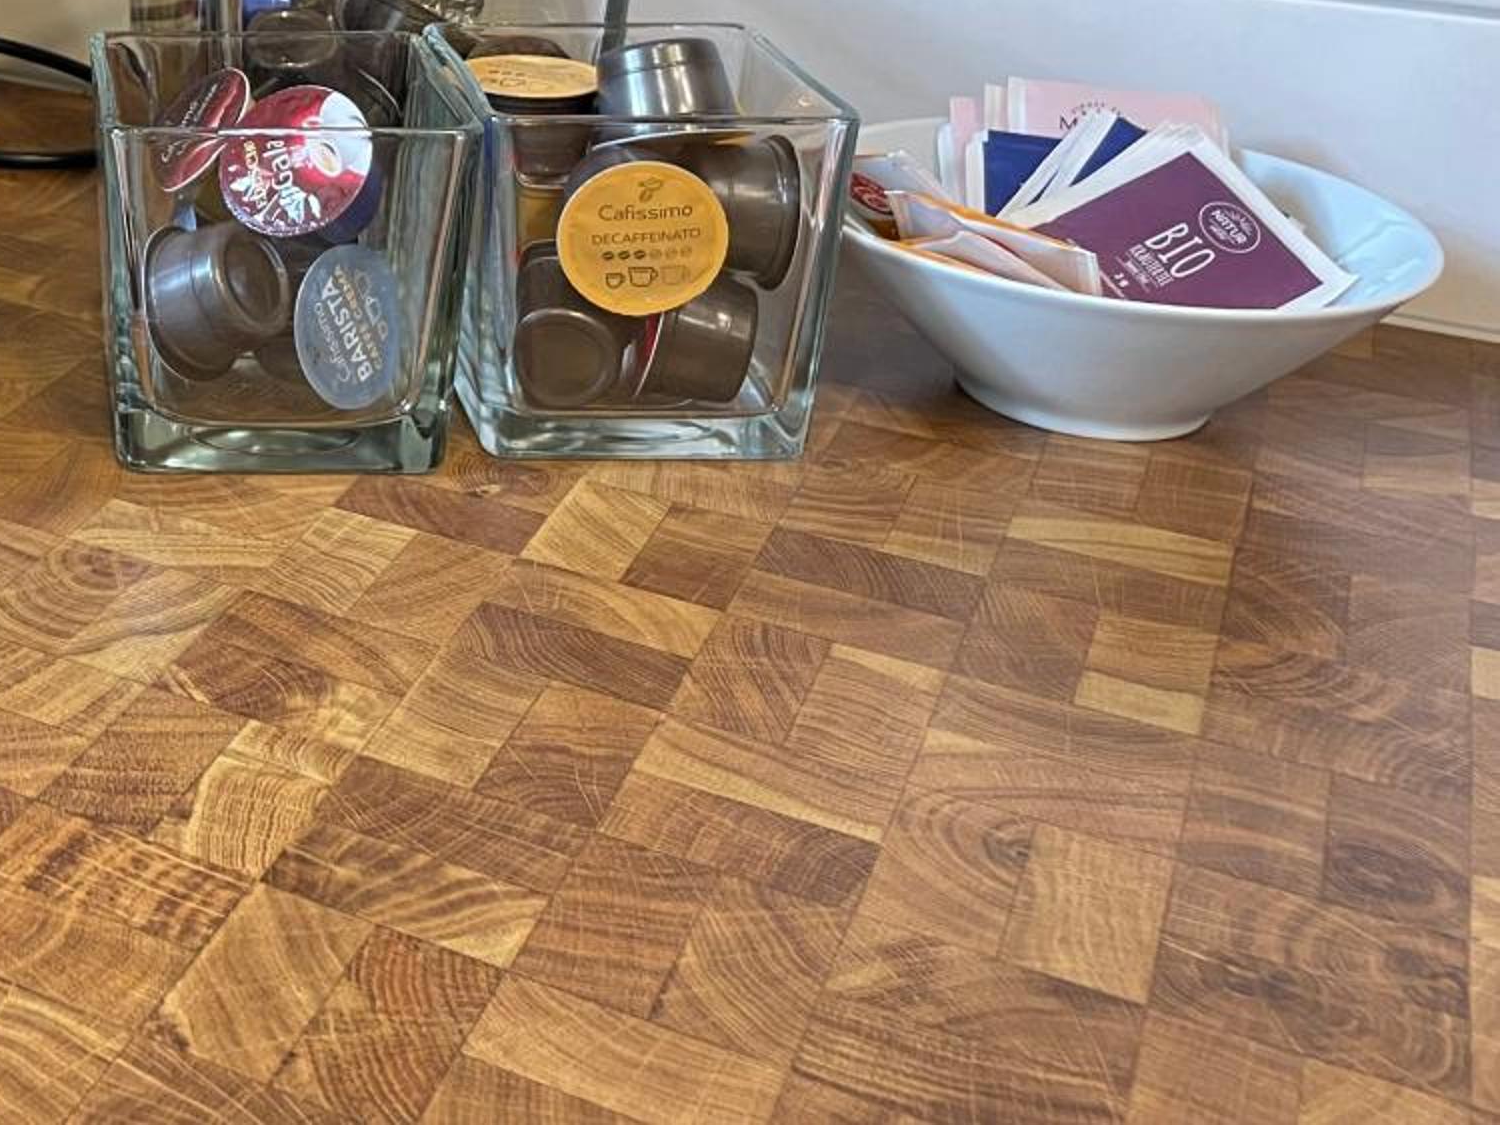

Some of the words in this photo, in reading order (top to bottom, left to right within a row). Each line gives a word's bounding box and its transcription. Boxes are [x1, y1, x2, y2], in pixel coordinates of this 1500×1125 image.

[263, 140, 293, 190] Gala
[590, 226, 702, 246] DECAFFEINATO
[598, 203, 694, 222] Cafissimo
[1144, 222, 1216, 278] BIO
[321, 275, 374, 383] BARISTA
